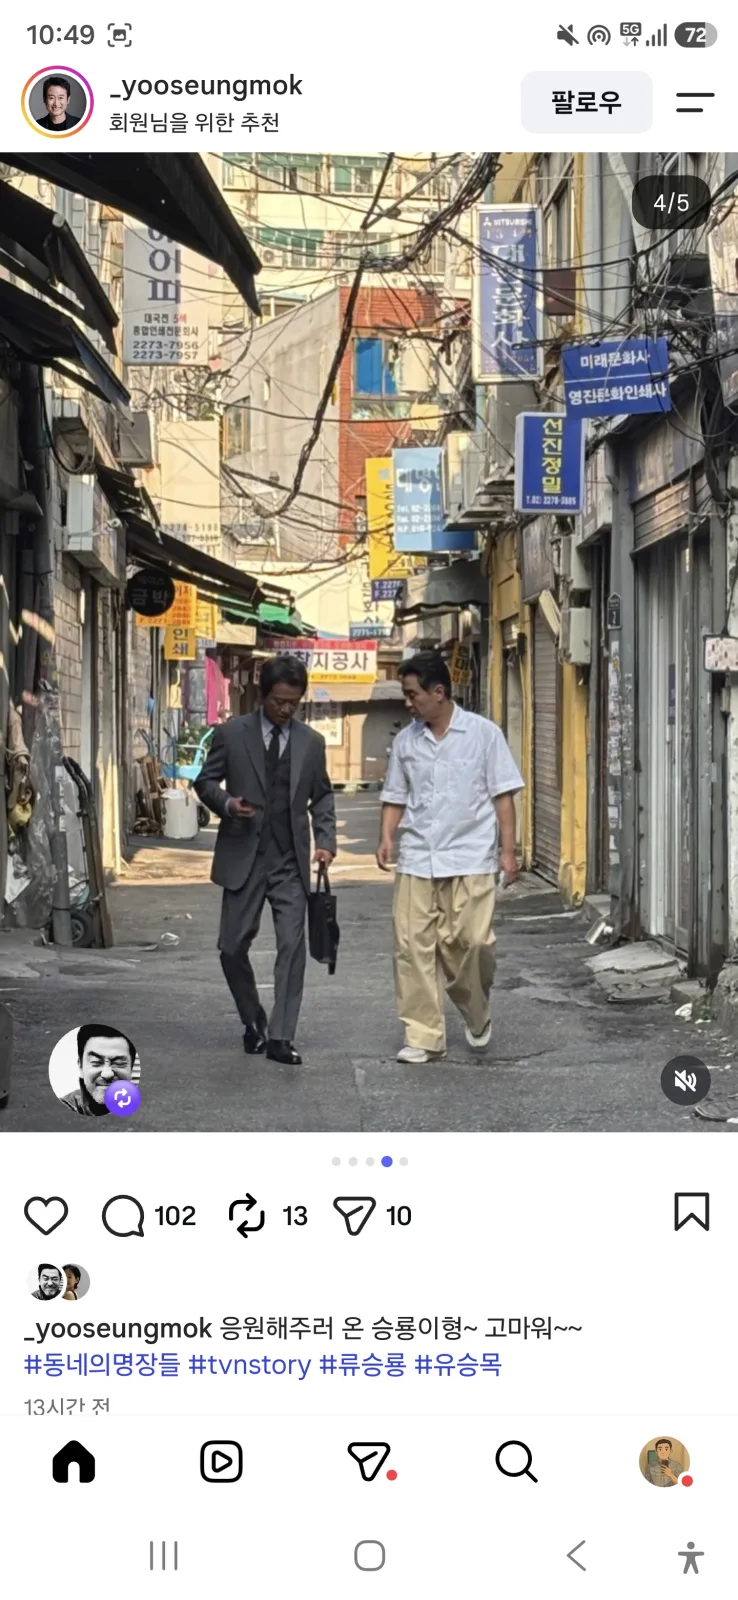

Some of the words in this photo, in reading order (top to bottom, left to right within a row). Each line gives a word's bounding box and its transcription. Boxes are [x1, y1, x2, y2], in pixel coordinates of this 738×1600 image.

[133, 340, 199, 350] 2273-7956
[133, 350, 199, 360] 2273-7957
[580, 350, 651, 369] 미래문화사
[568, 382, 667, 406] 영진문화인쇄사
[541, 418, 563, 495] 선진정밀
[395, 467, 441, 494] 대명
[171, 627, 189, 656] 인쇄
[277, 650, 369, 671] 착지공사
